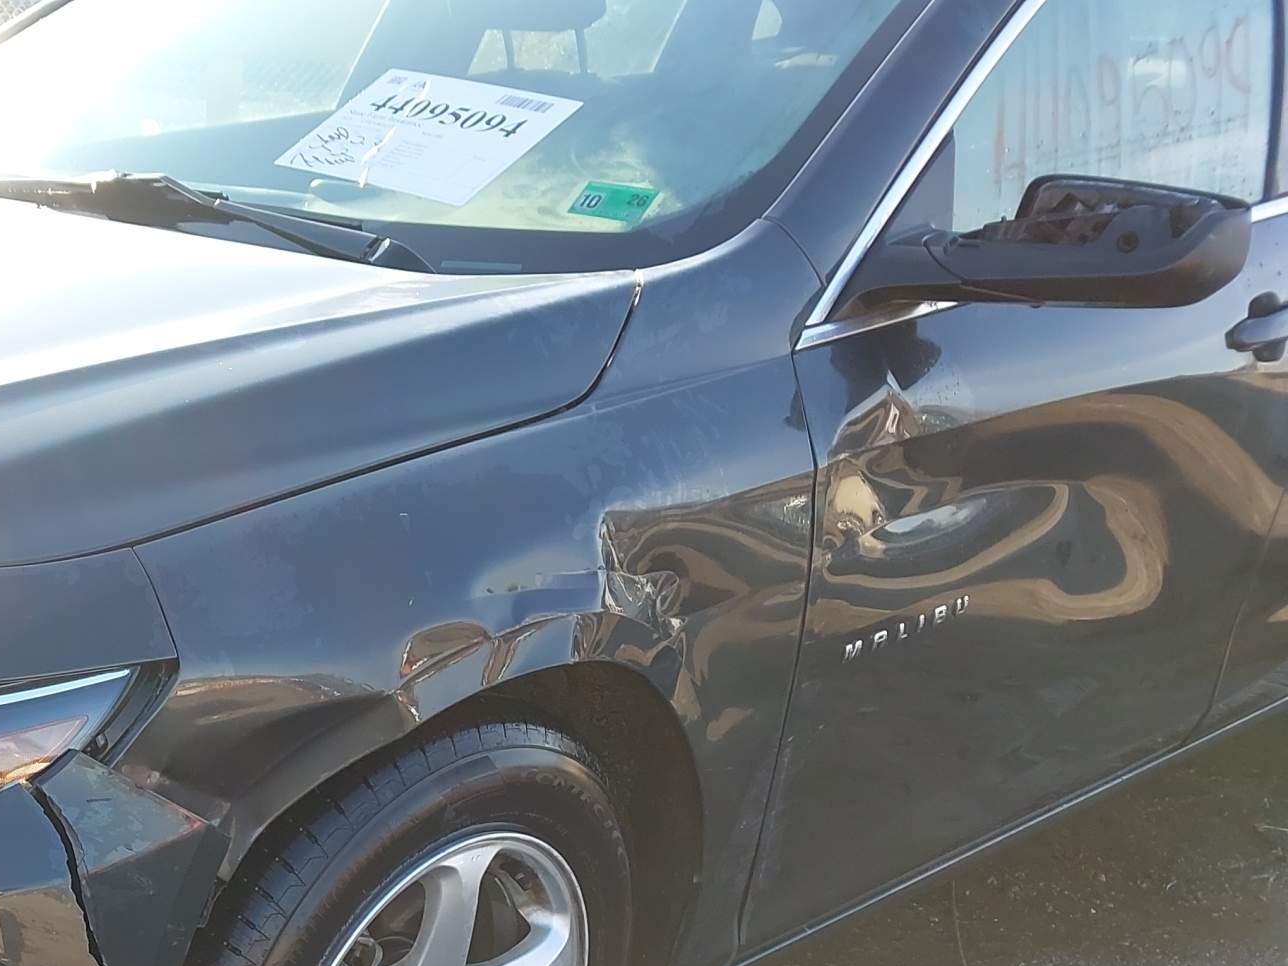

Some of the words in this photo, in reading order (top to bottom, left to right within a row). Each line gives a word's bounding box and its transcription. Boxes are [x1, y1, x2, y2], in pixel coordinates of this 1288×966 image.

[370, 94, 528, 138] 44095094
[579, 193, 603, 209] 10
[843, 595, 969, 662] MALIBU
